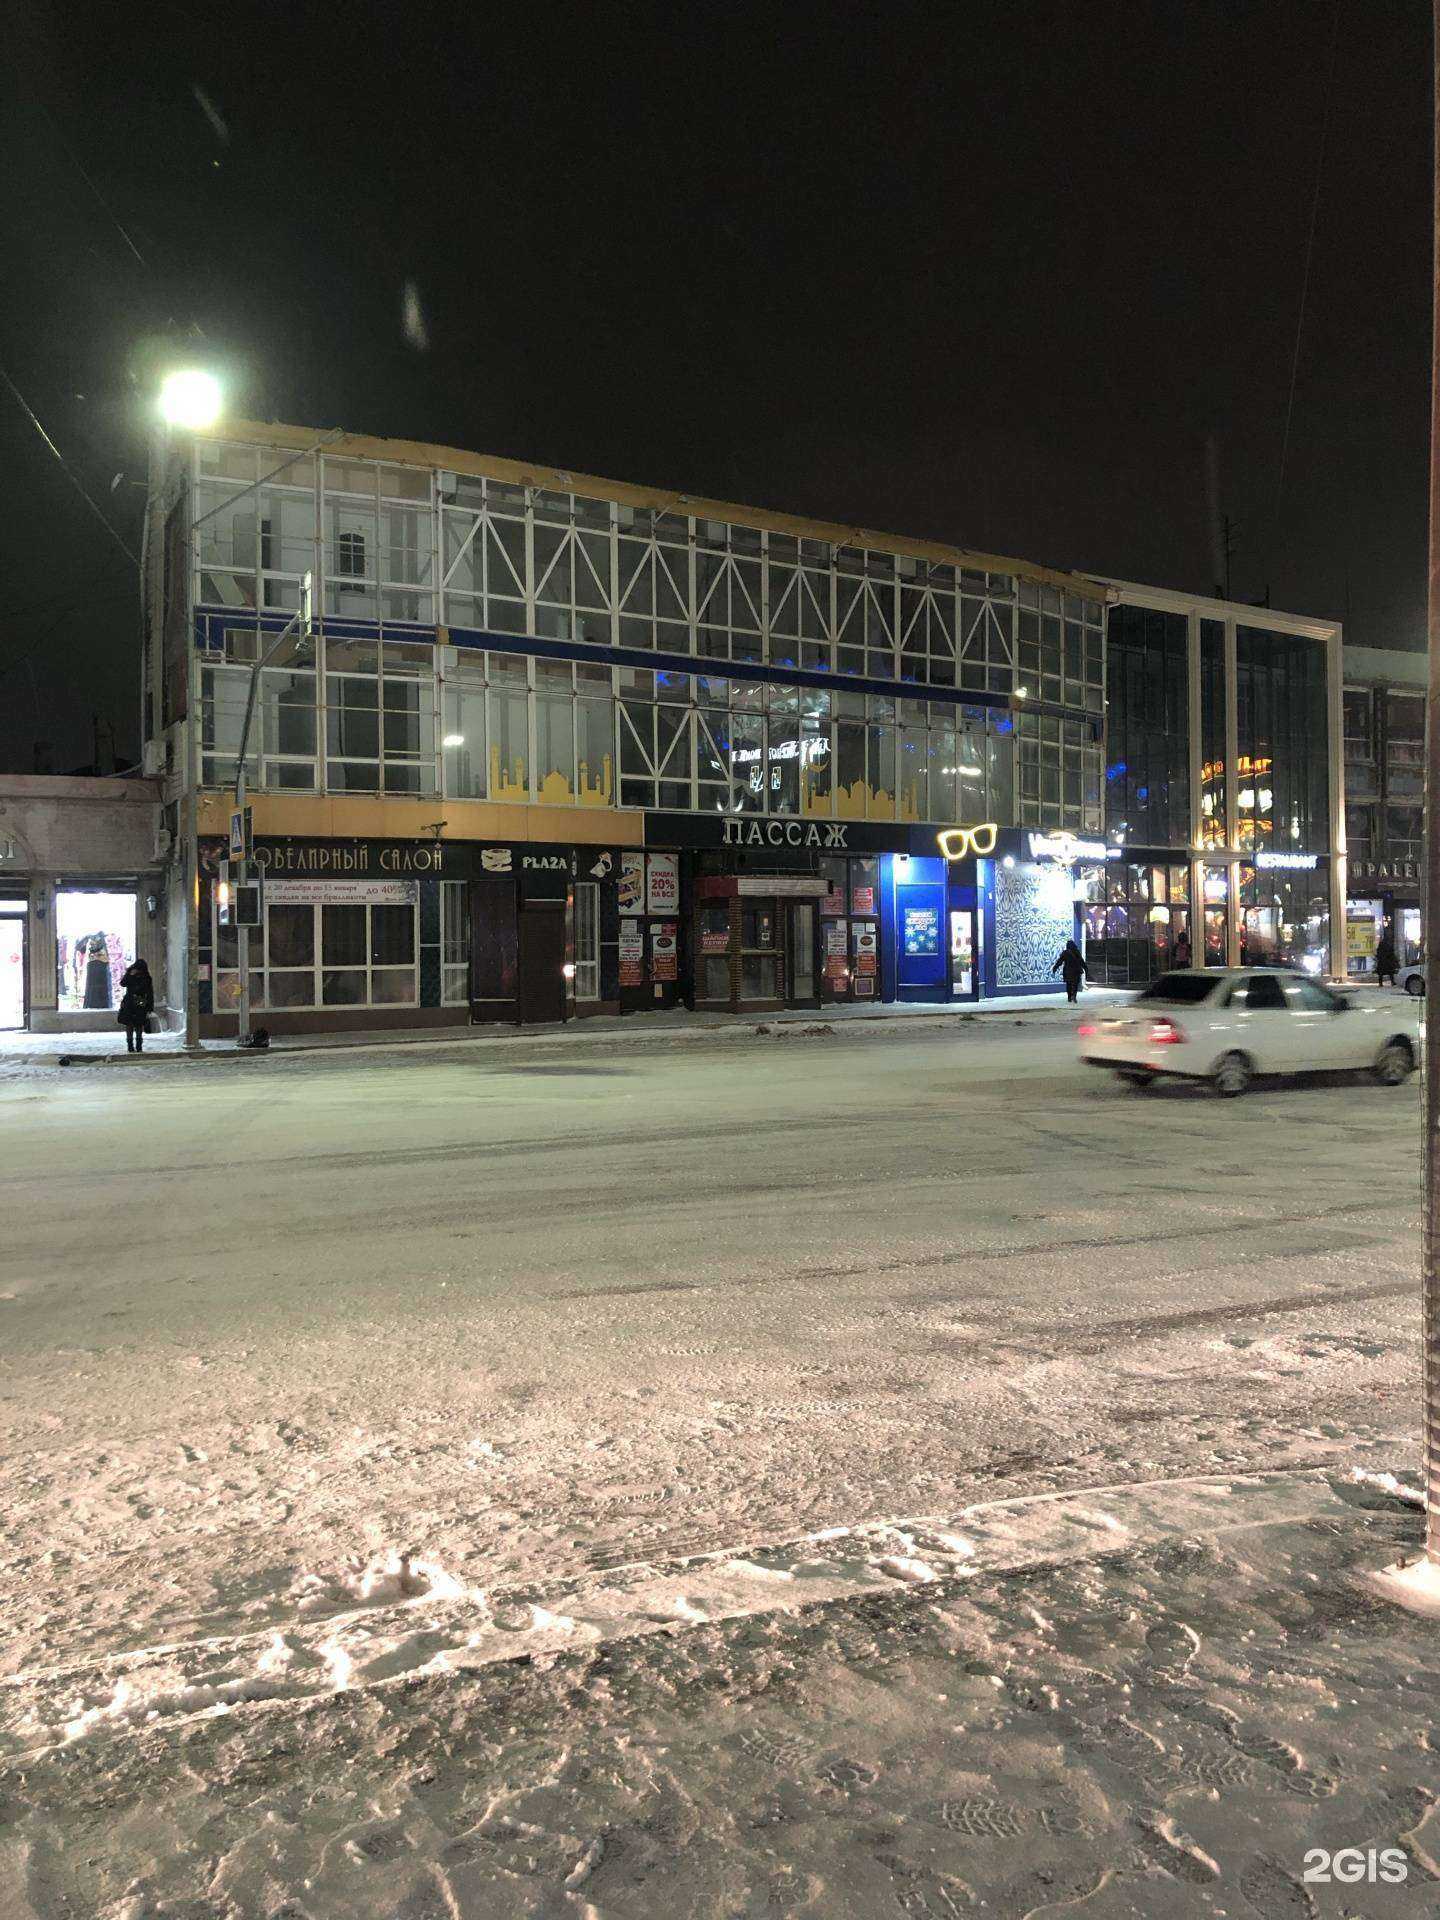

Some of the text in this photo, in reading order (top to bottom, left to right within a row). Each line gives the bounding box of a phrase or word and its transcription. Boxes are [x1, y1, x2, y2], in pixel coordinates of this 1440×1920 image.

[722, 818, 848, 848] ПАССАЖ
[379, 849, 442, 870] САЛОН
[522, 856, 568, 869] PLAZA
[651, 878, 675, 890] 20%
[366, 887, 379, 895] до
